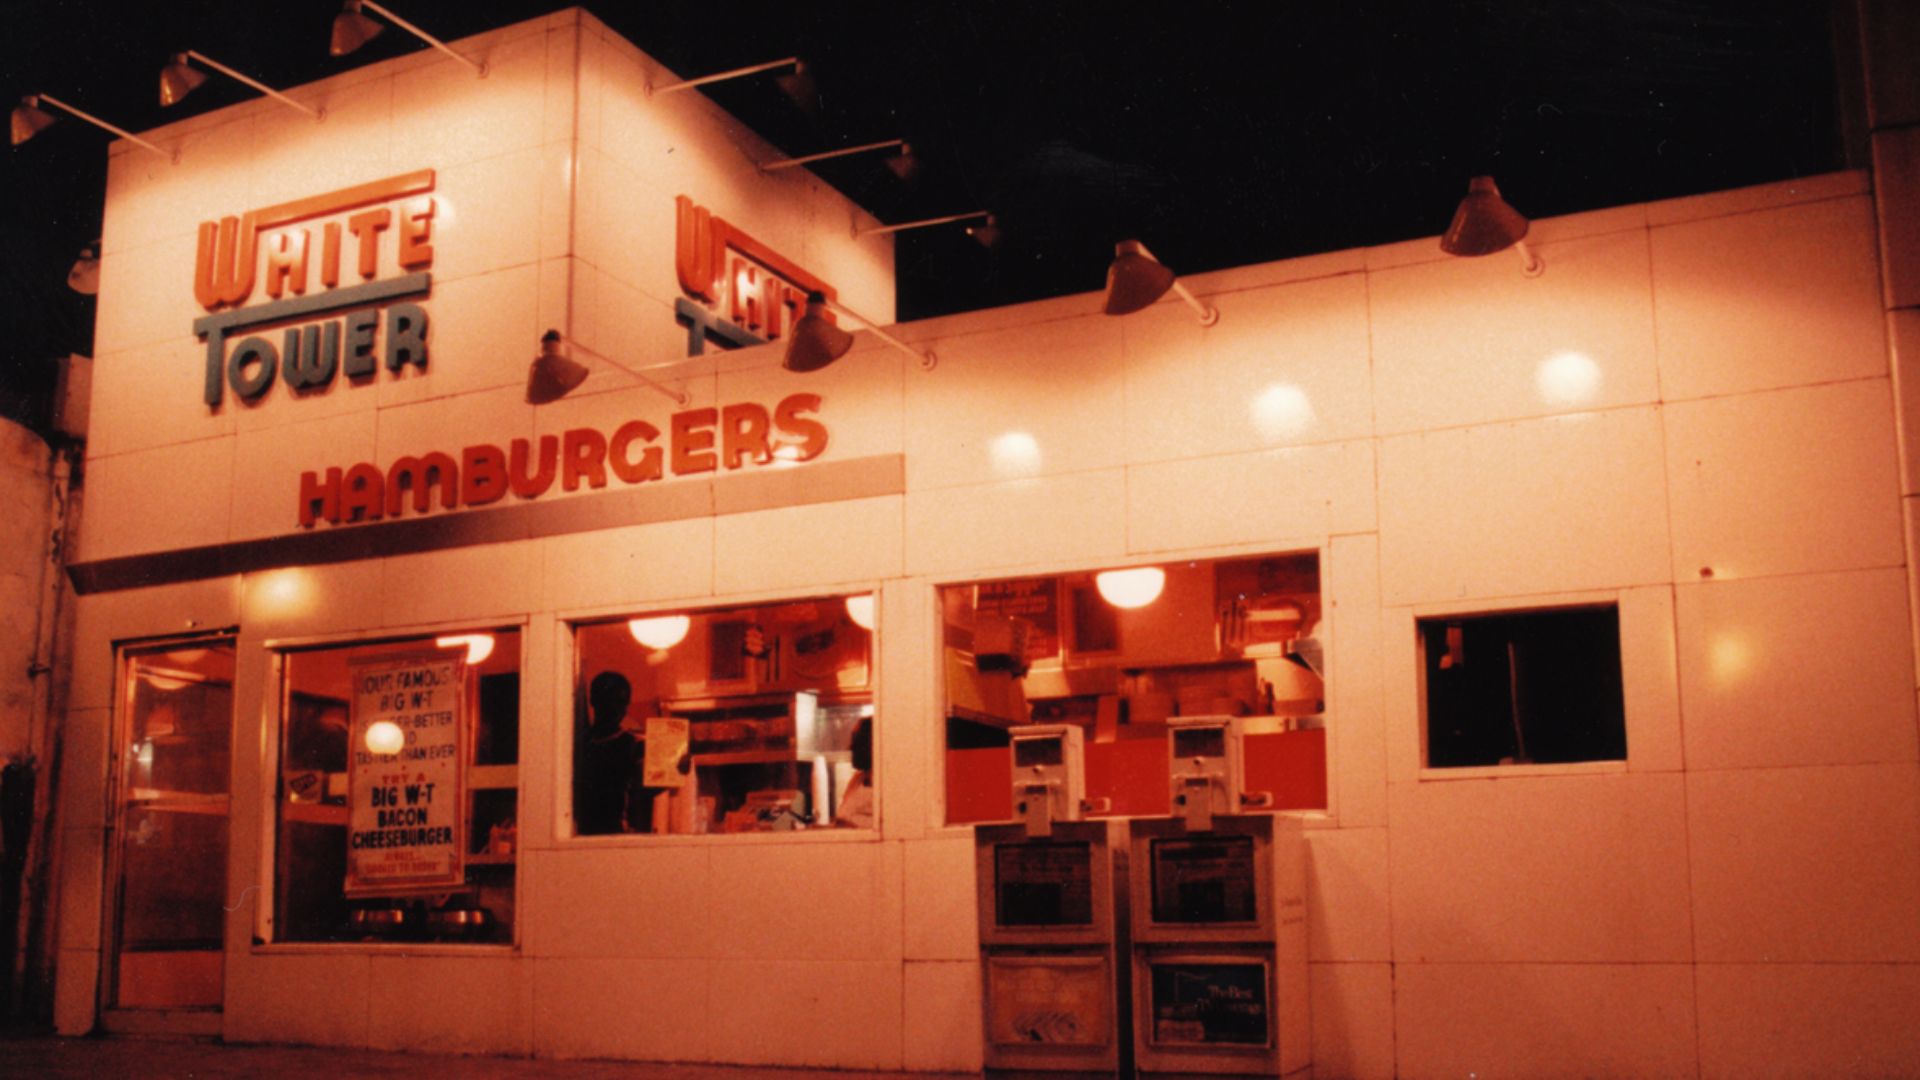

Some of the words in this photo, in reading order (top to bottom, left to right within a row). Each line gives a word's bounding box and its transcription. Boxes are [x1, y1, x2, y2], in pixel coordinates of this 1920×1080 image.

[194, 168, 436, 312] WHITE
[675, 194, 838, 340] WHIT
[193, 272, 432, 410] TOWER
[300, 392, 829, 528] HAMBURGERS
[429, 744, 455, 759] EVER
[416, 772, 426, 782] A
[371, 786, 398, 807] BIG
[404, 783, 435, 804] W-T
[378, 808, 427, 827] BACON
[352, 827, 452, 849] CHEESEBURGER
